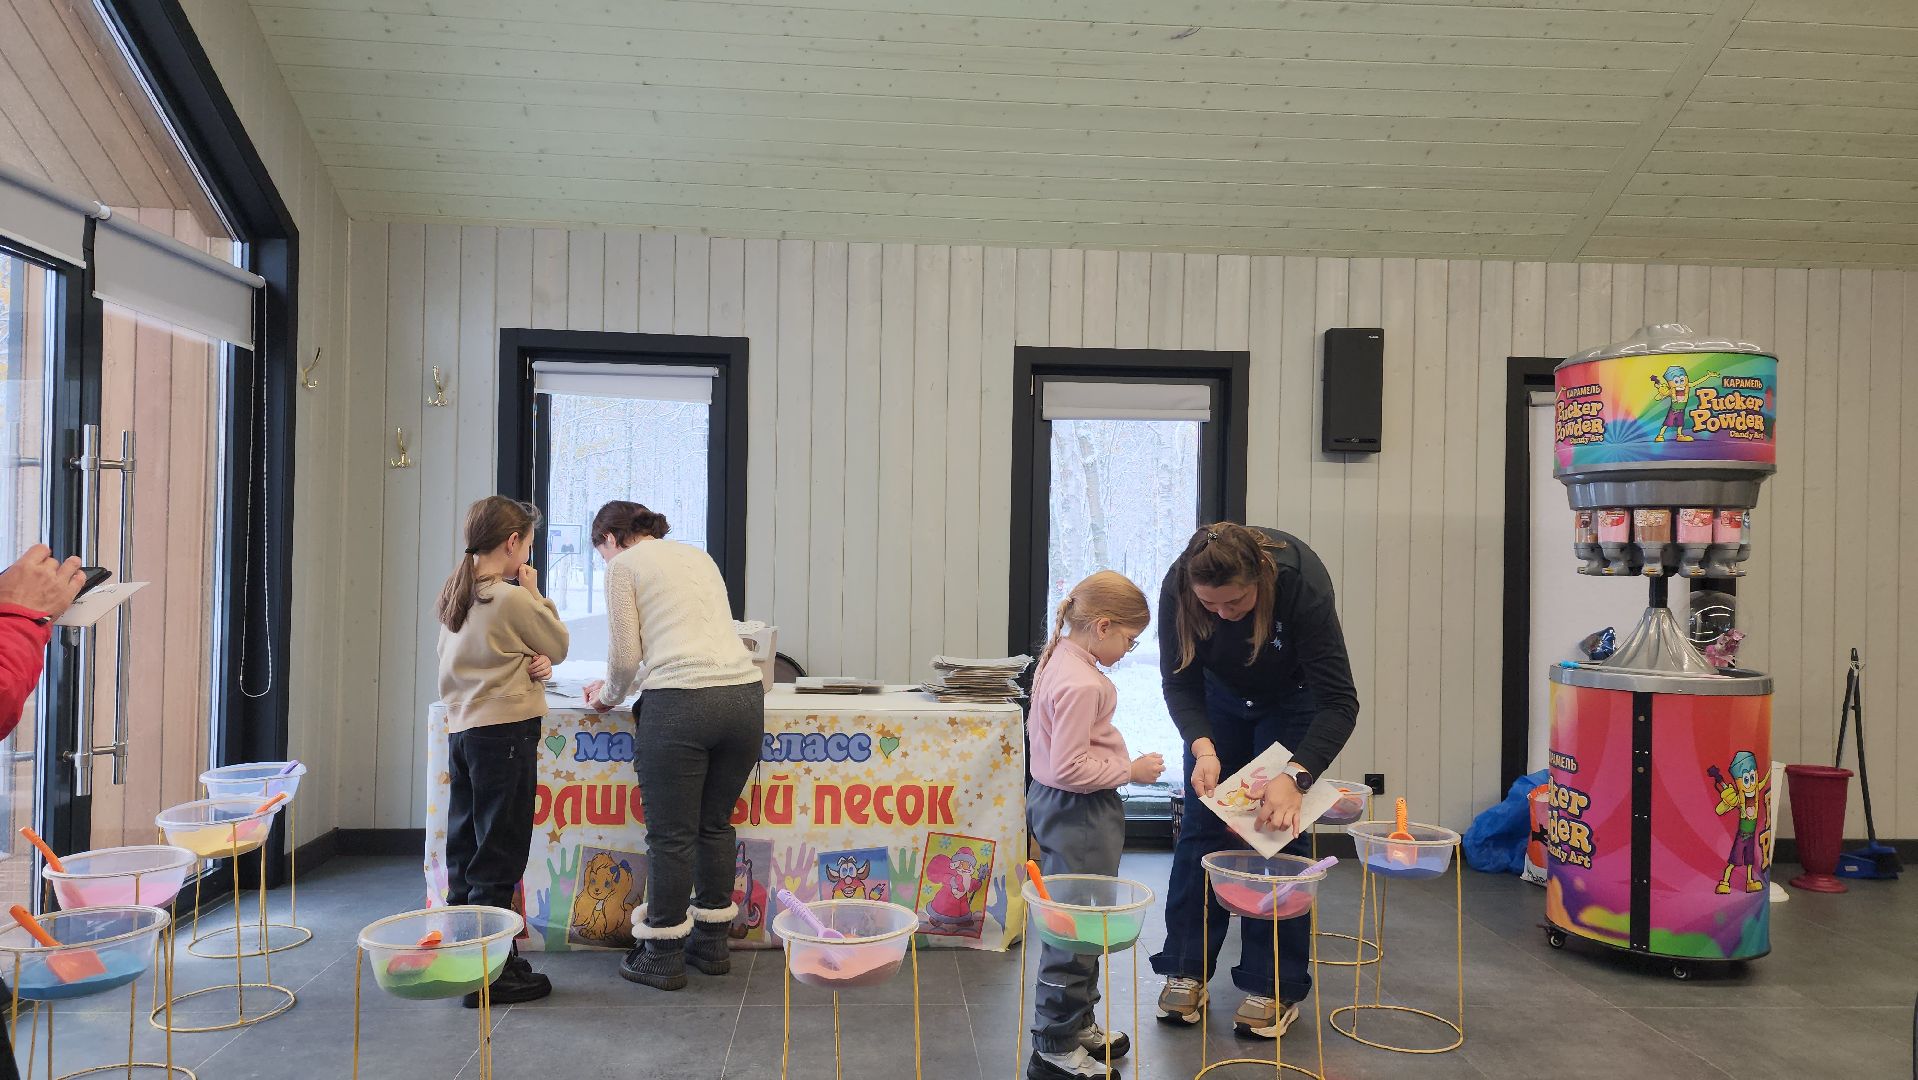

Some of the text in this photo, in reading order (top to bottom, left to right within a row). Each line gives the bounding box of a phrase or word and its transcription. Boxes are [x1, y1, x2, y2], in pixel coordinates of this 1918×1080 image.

[1723, 377, 1763, 389] КАРАМЕЛЬ
[1696, 388, 1764, 411] Pucker
[1729, 430, 1754, 440] Candy
[814, 783, 955, 827] песок
[1568, 850, 1591, 868] Art
